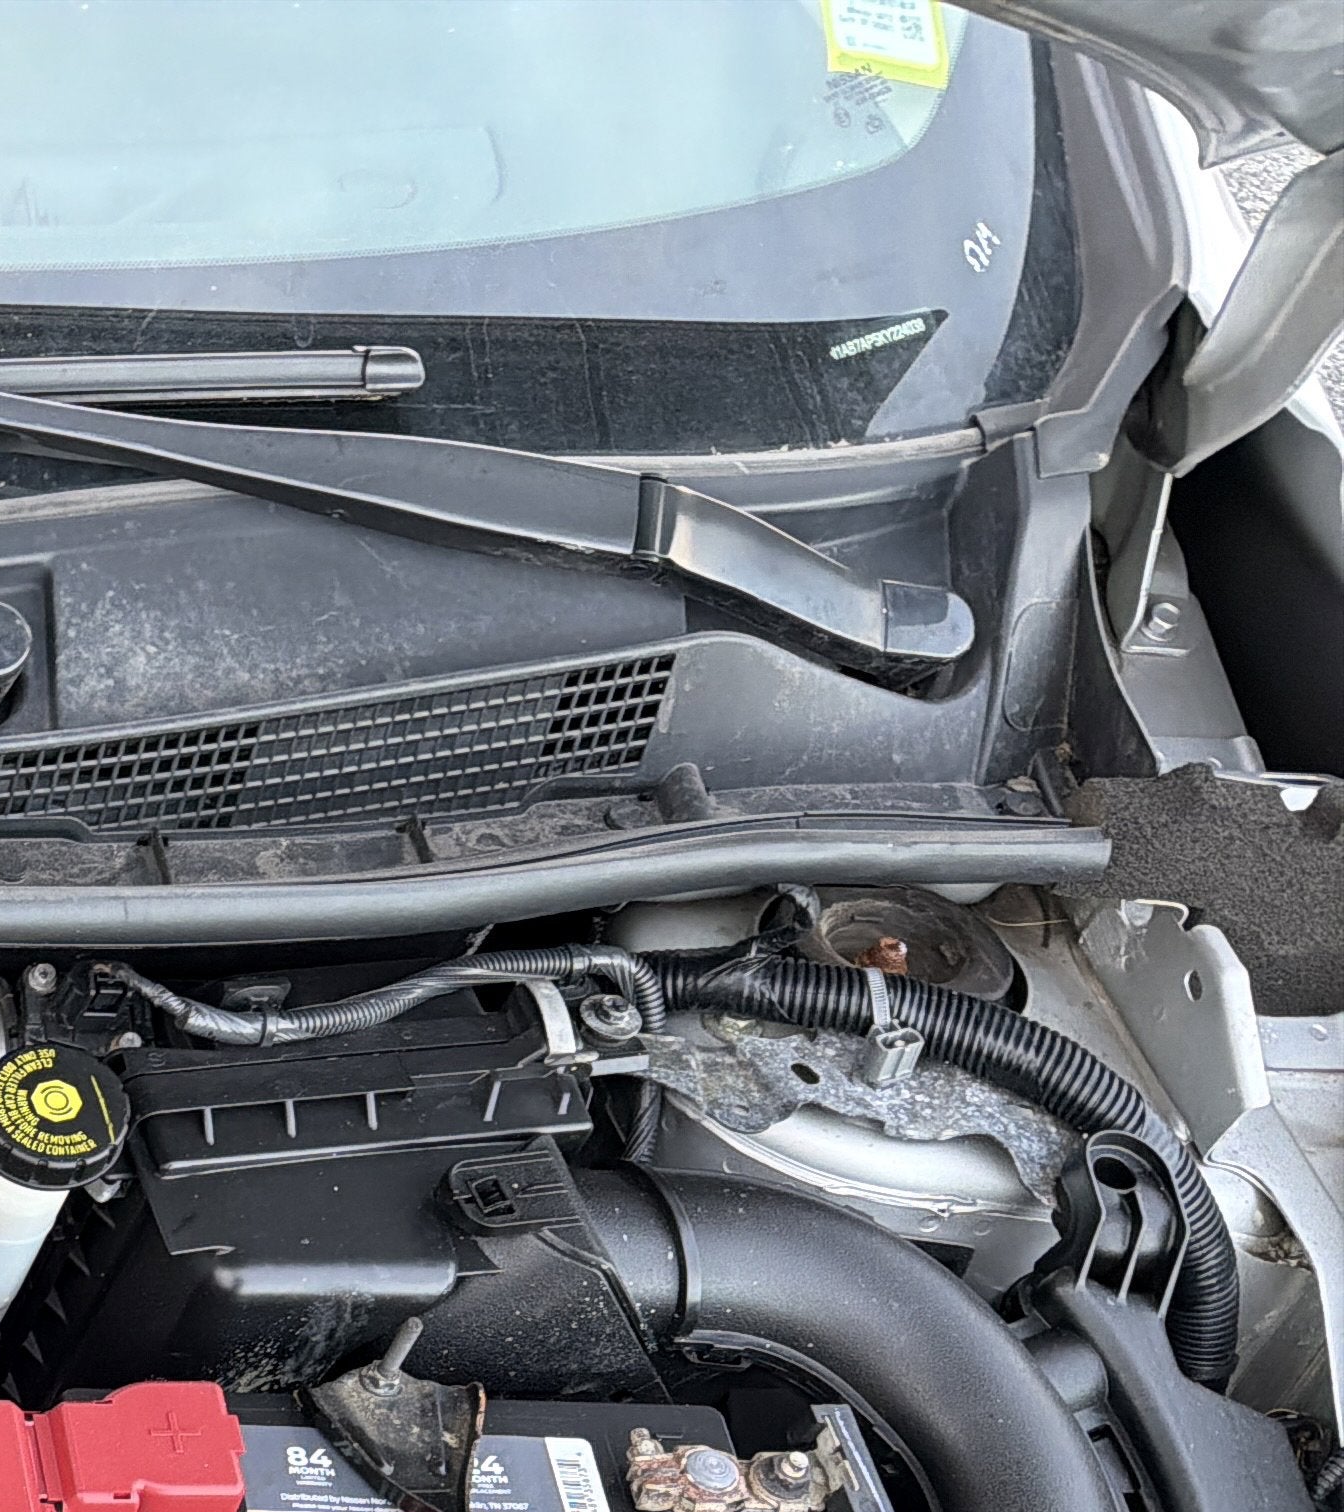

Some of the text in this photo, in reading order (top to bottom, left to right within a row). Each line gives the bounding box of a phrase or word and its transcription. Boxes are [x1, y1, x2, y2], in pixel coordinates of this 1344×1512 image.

[39, 1049, 56, 1058] USE
[4, 1058, 88, 1145] CLEAN FILLER CAP BEFORE REMOVING
[17, 1090, 40, 1126] WARNING
[12, 1128, 45, 1153] SEALED
[46, 1139, 98, 1156] CONTAINER
[286, 1446, 333, 1468] 84
[288, 1467, 336, 1477] MONTH
[472, 1475, 509, 1484] ONTH
[280, 1492, 328, 1502] Distributed
[329, 1494, 340, 1505] by
[341, 1495, 370, 1505] Nissan
